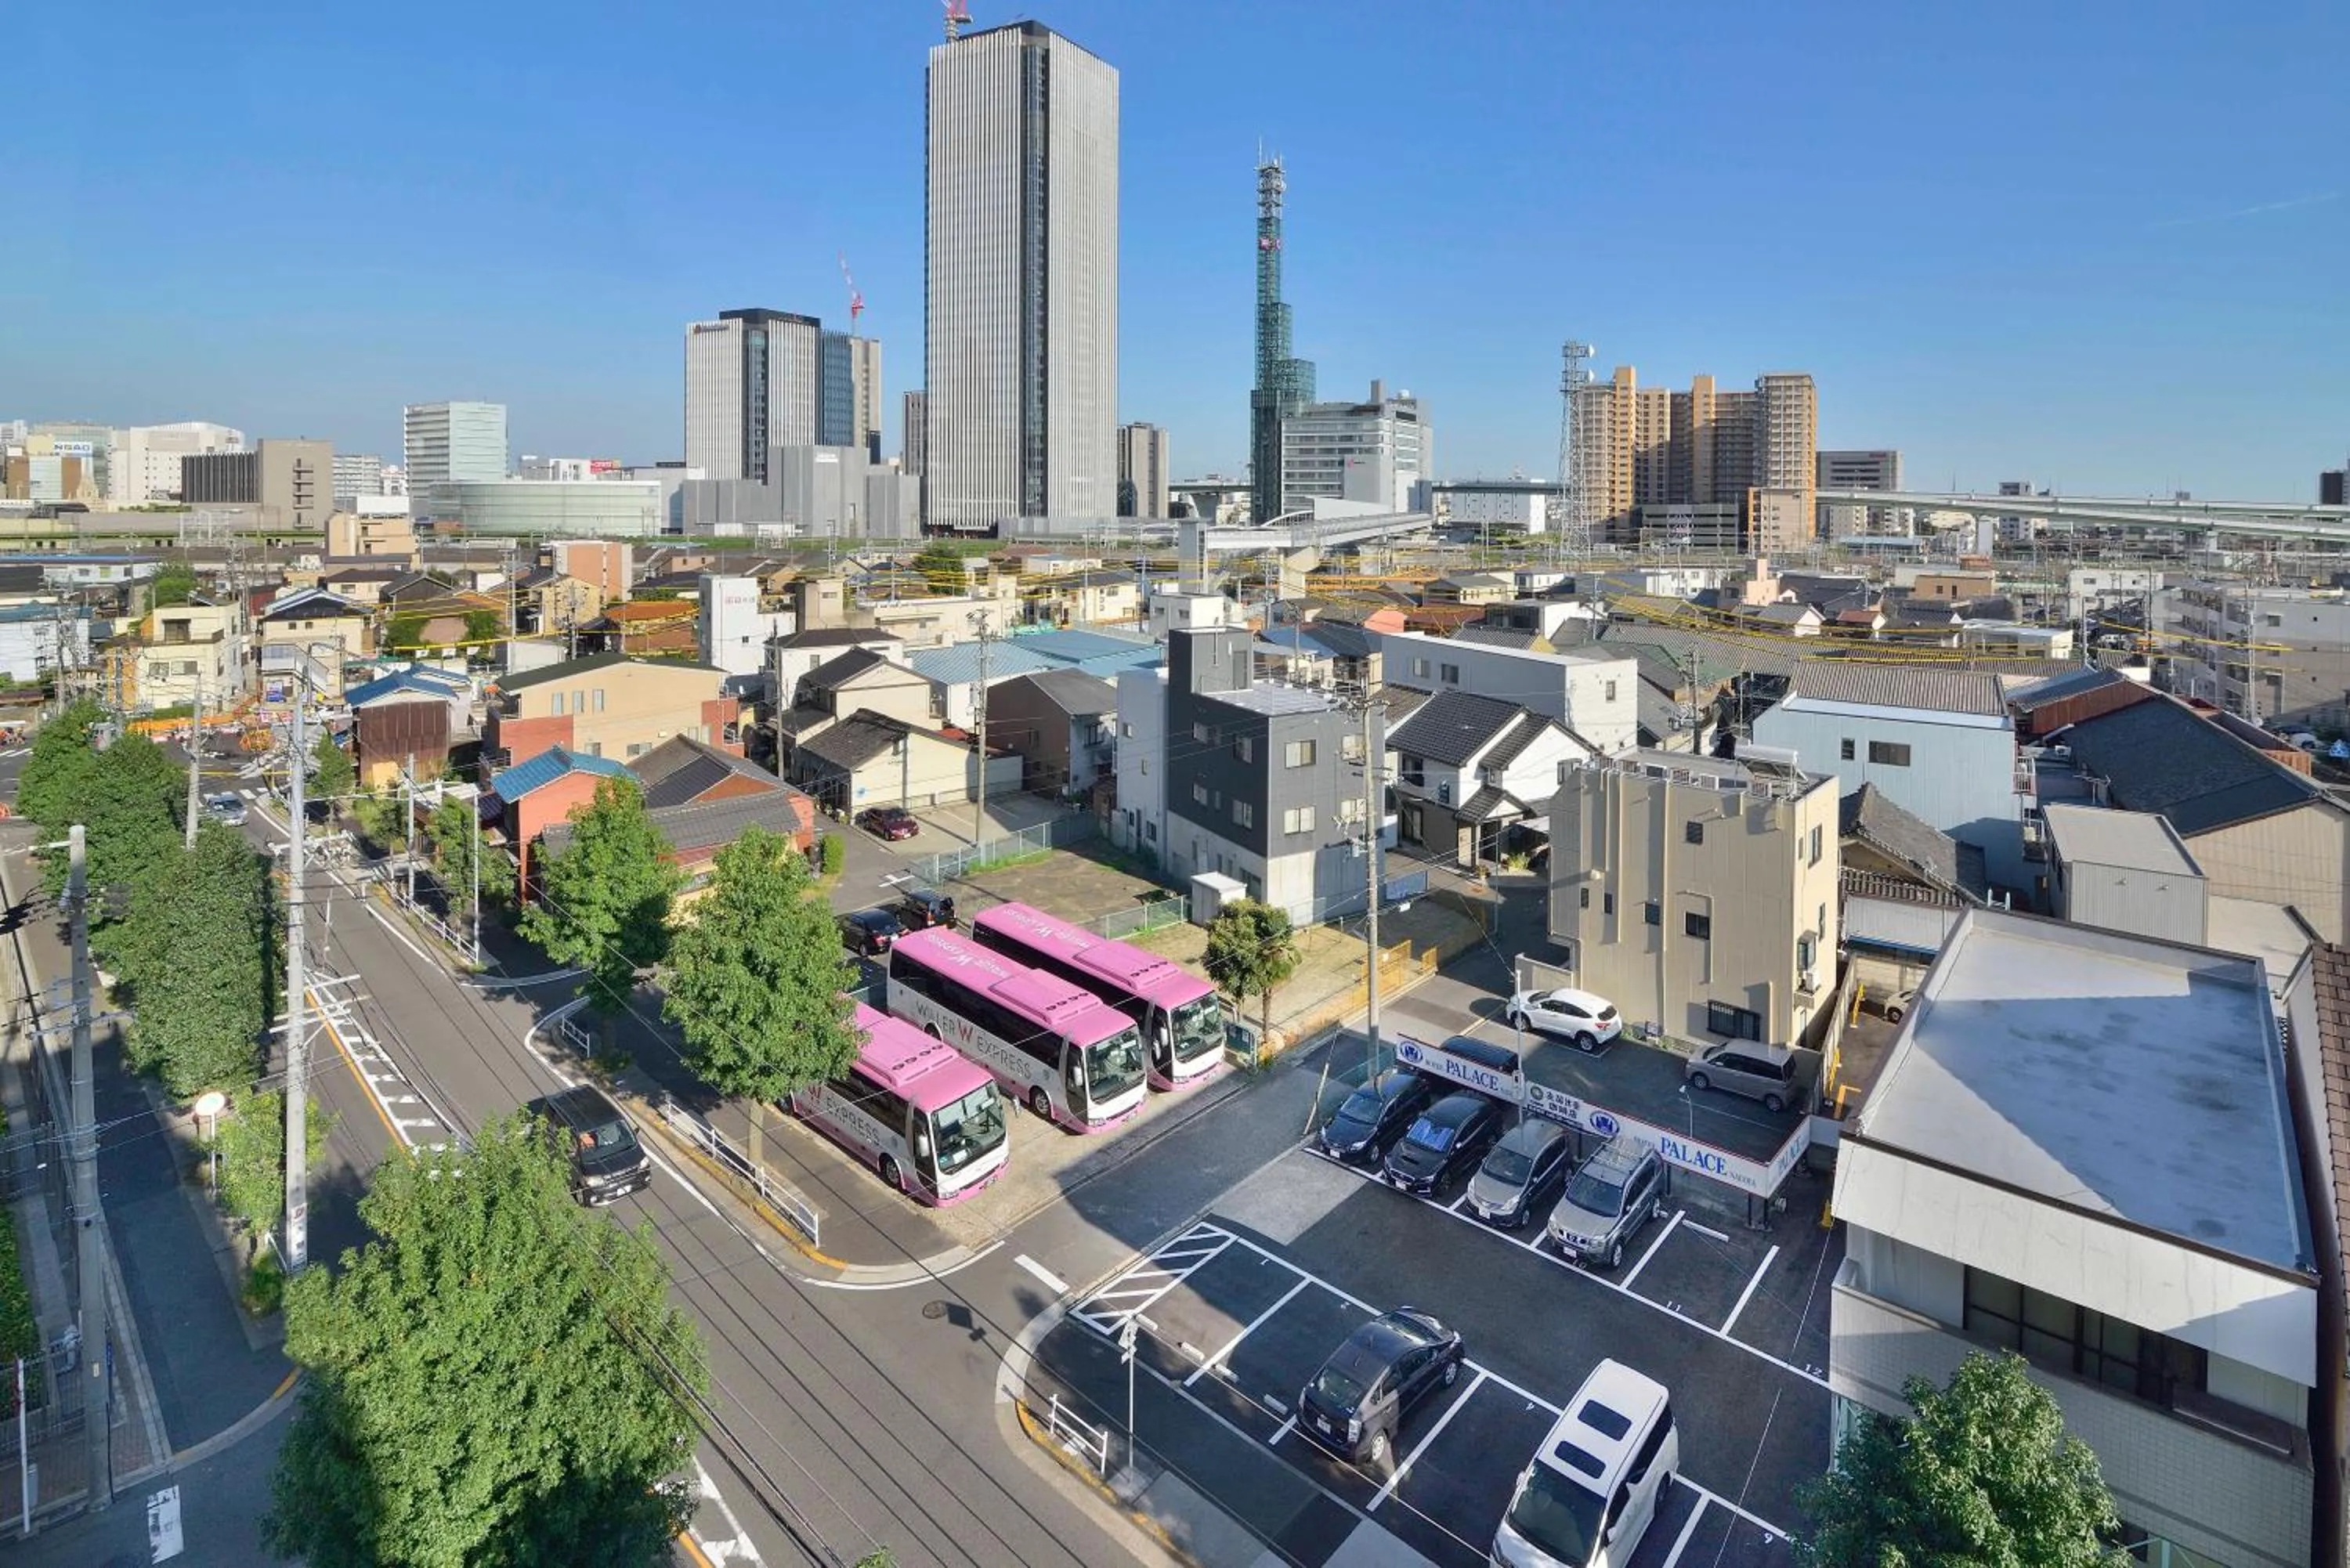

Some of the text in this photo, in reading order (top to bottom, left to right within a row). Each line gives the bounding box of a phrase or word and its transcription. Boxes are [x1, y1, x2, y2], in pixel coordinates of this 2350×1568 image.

[916, 1001, 1033, 1081] WILLER W EXPRESS
[1445, 1059, 1499, 1091] PALACE
[826, 1096, 880, 1146] EXPRESS
[1660, 1136, 1727, 1176] PALACE
[1805, 1364, 1823, 1378] 12
